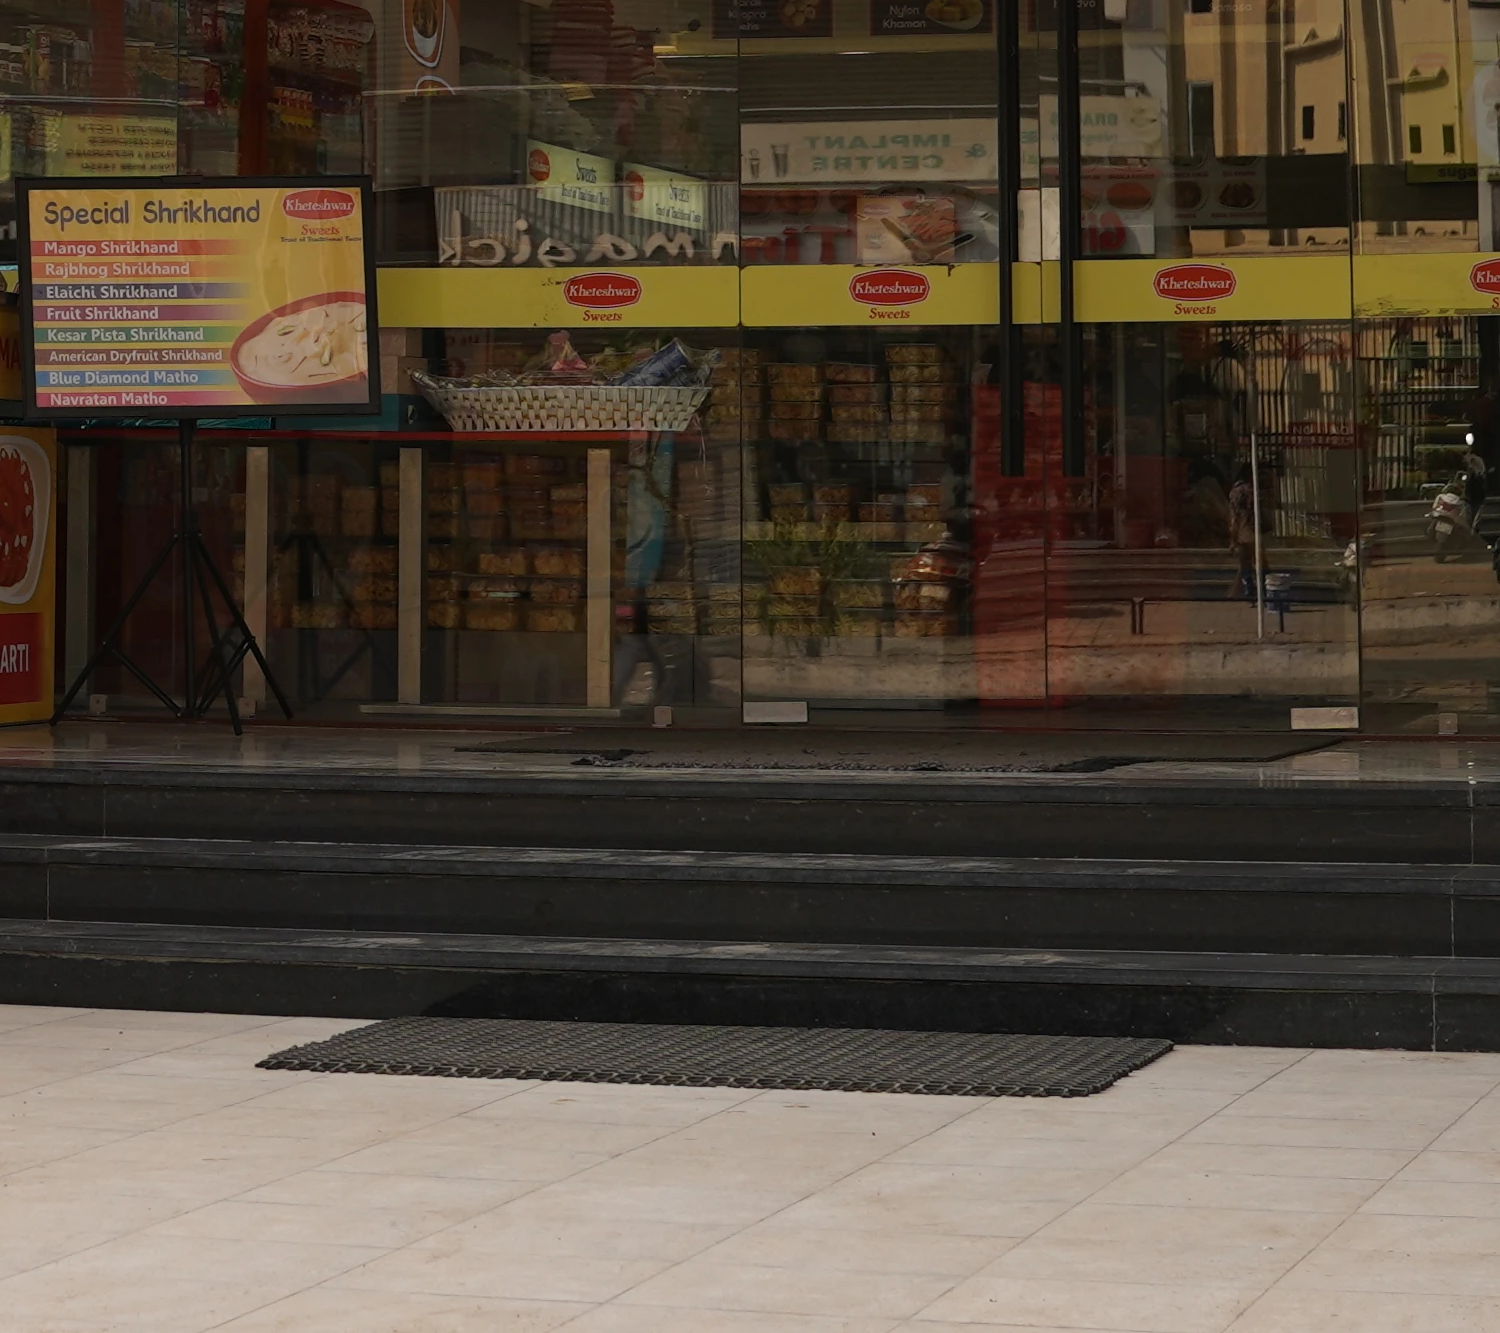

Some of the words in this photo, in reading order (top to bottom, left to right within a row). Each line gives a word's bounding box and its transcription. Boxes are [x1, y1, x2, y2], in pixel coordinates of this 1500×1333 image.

[889, 5, 919, 17] Nylon
[882, 19, 926, 29] Khaman
[286, 198, 353, 210] Kheteshwar
[44, 199, 129, 232] Special
[143, 199, 260, 223] Shrikhand
[44, 241, 96, 257] Mango
[101, 241, 178, 254] Shrikhand
[45, 263, 108, 278] Rajbhog
[112, 262, 190, 275] Shrikhand
[46, 286, 96, 299] Elaichi
[101, 285, 178, 298] Shrikhand
[568, 284, 638, 298] Kheteshwar
[47, 307, 81, 321] Fruit
[85, 307, 159, 320] Shrikhand
[583, 310, 622, 322] Sweets
[47, 329, 87, 342] Kesar
[91, 329, 126, 341] Pista
[131, 328, 204, 341] Shrikhand
[50, 350, 106, 362] American
[110, 350, 159, 364] Dryfruit
[162, 349, 222, 361] Shrikhand
[50, 371, 80, 384] Blue
[85, 371, 149, 384] Diamond
[154, 370, 198, 383] Matho
[50, 393, 117, 406] Navratan
[121, 392, 168, 405] Matho
